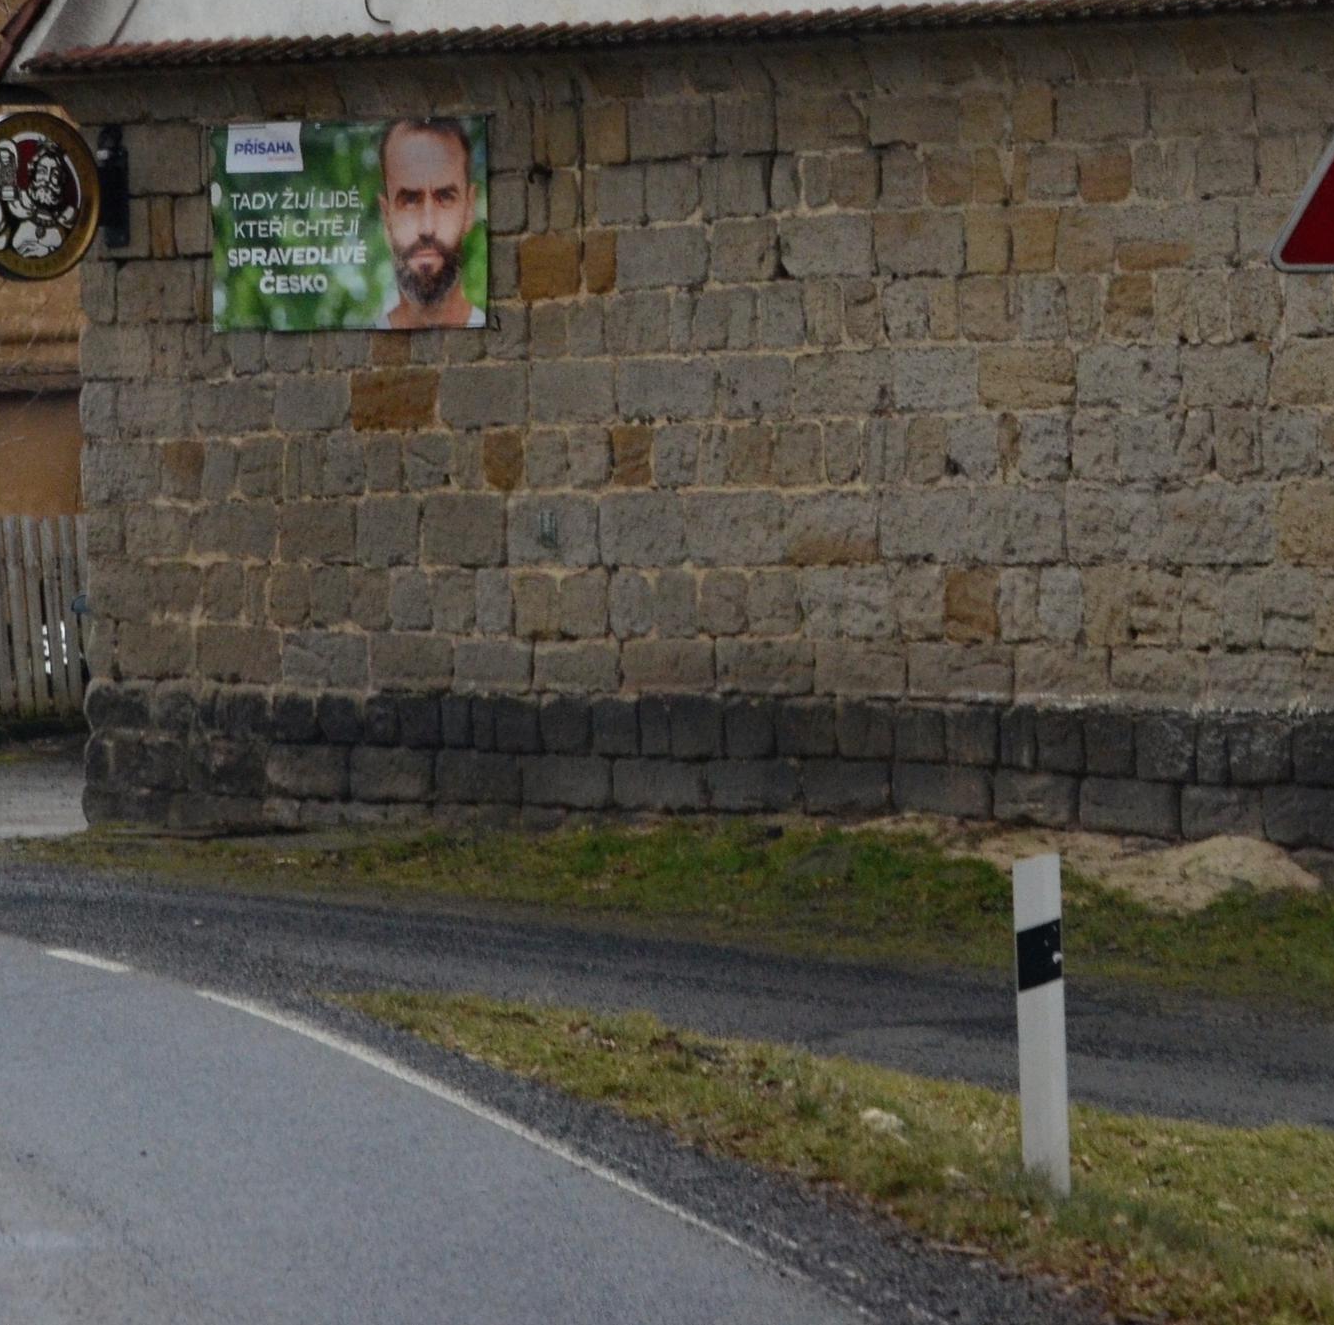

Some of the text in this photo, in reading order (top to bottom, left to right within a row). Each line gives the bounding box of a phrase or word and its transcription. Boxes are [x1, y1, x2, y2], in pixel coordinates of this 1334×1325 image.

[233, 139, 295, 156] PŘÍSAHA
[230, 185, 365, 211] TADY ŽIJÍ LIDÉ,
[234, 214, 361, 239] KTEŘÍ CHTĚJÍ
[228, 241, 367, 268] SPRAVEDLIVÉ
[259, 270, 328, 294] ČESKO
